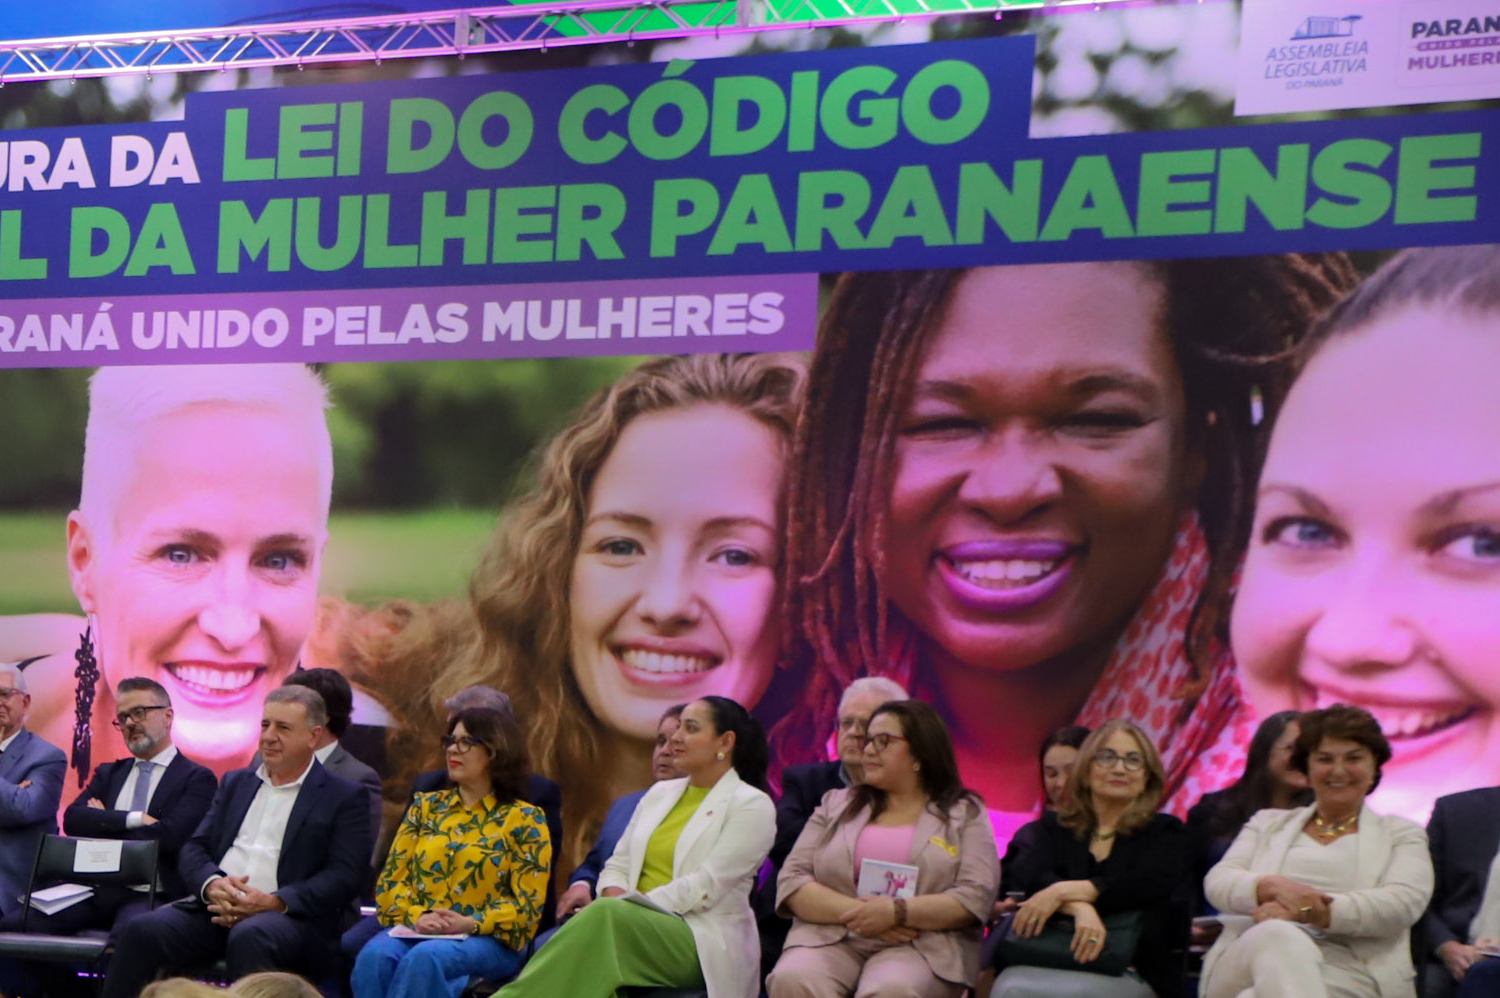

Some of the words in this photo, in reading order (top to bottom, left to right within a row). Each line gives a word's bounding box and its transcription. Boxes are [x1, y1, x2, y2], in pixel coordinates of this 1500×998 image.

[1264, 57, 1366, 79] LEGISLATIVA
[1265, 40, 1368, 62] ASSEMBLEIA
[110, 131, 201, 189] DA
[222, 100, 363, 182] LEI
[386, 88, 534, 174] DO
[558, 58, 990, 166] CÓDIGO
[68, 202, 196, 280] DA
[216, 183, 625, 274] MULHER
[648, 131, 1482, 258] PARANAENSE
[131, 308, 290, 351] UNIDO
[302, 303, 469, 348] PELAS
[483, 292, 784, 344] MULHERES
